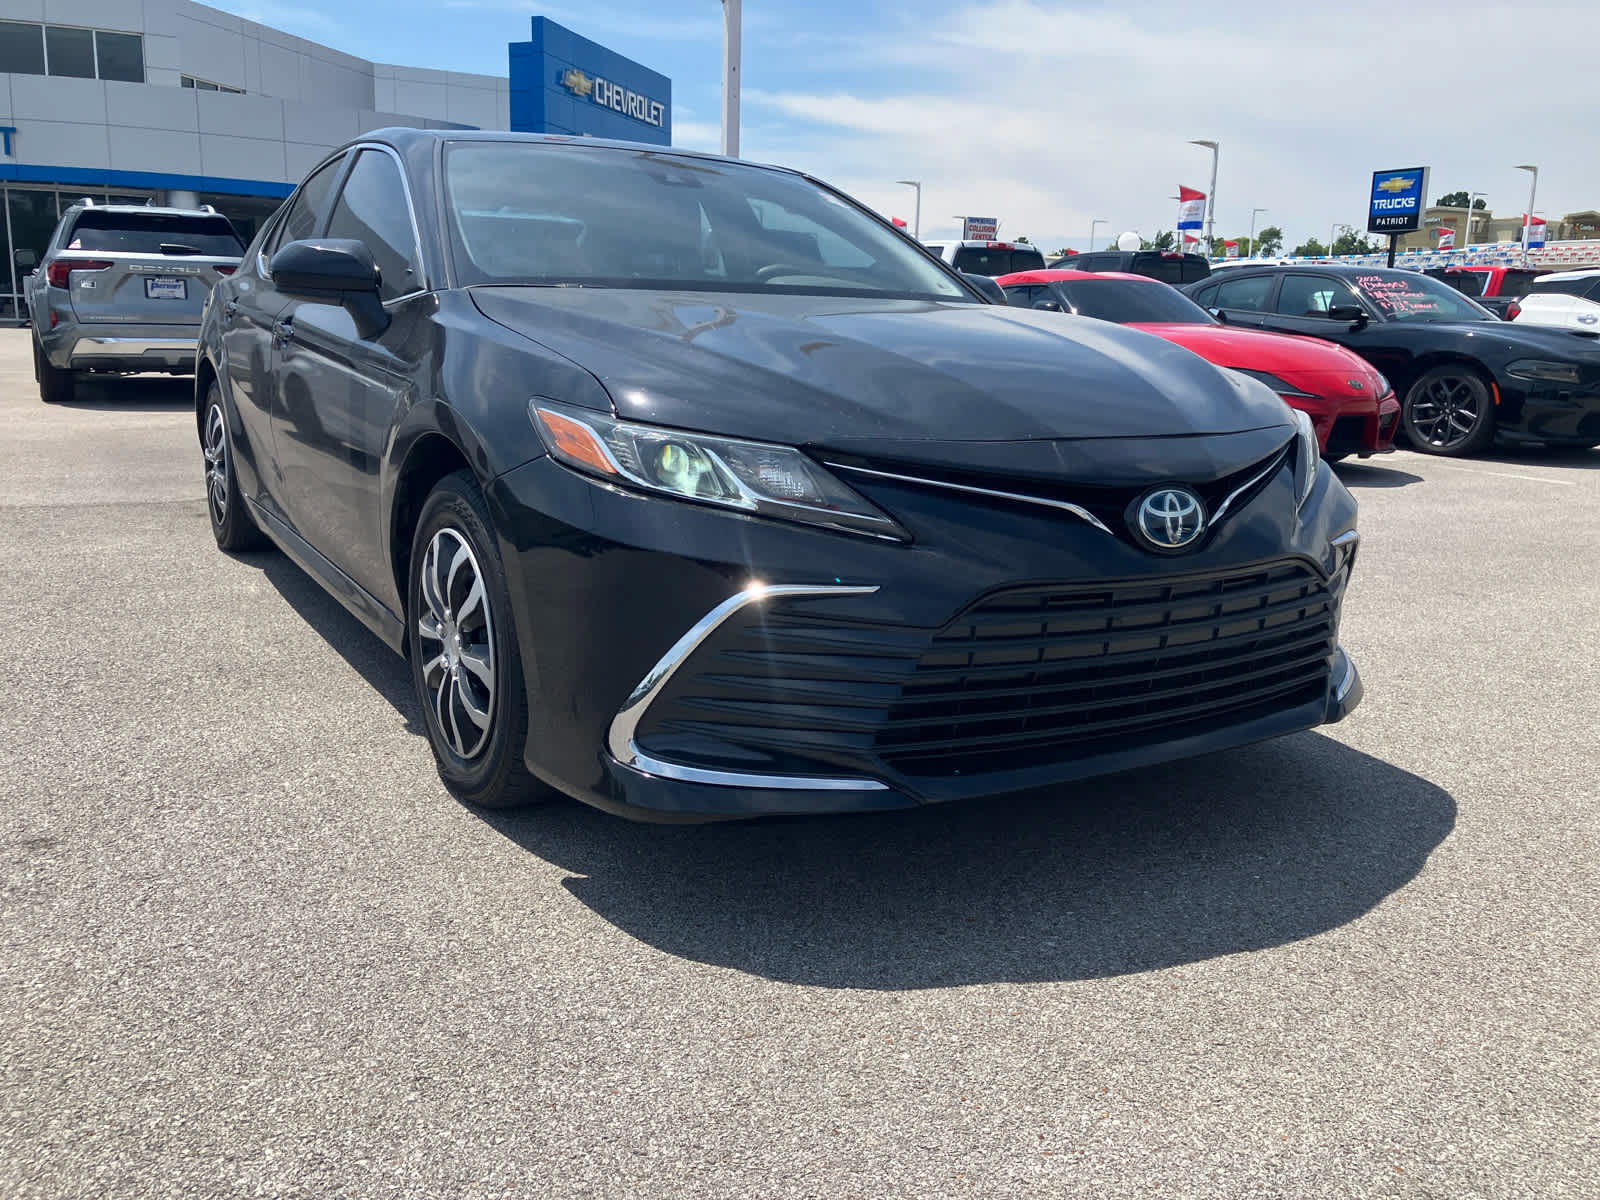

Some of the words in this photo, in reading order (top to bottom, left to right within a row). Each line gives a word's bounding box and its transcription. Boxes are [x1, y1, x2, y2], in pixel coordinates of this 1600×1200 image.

[595, 77, 665, 127] CHEVROLET
[1373, 197, 1416, 209] TRUCKS
[1376, 217, 1409, 225] PATRIOT
